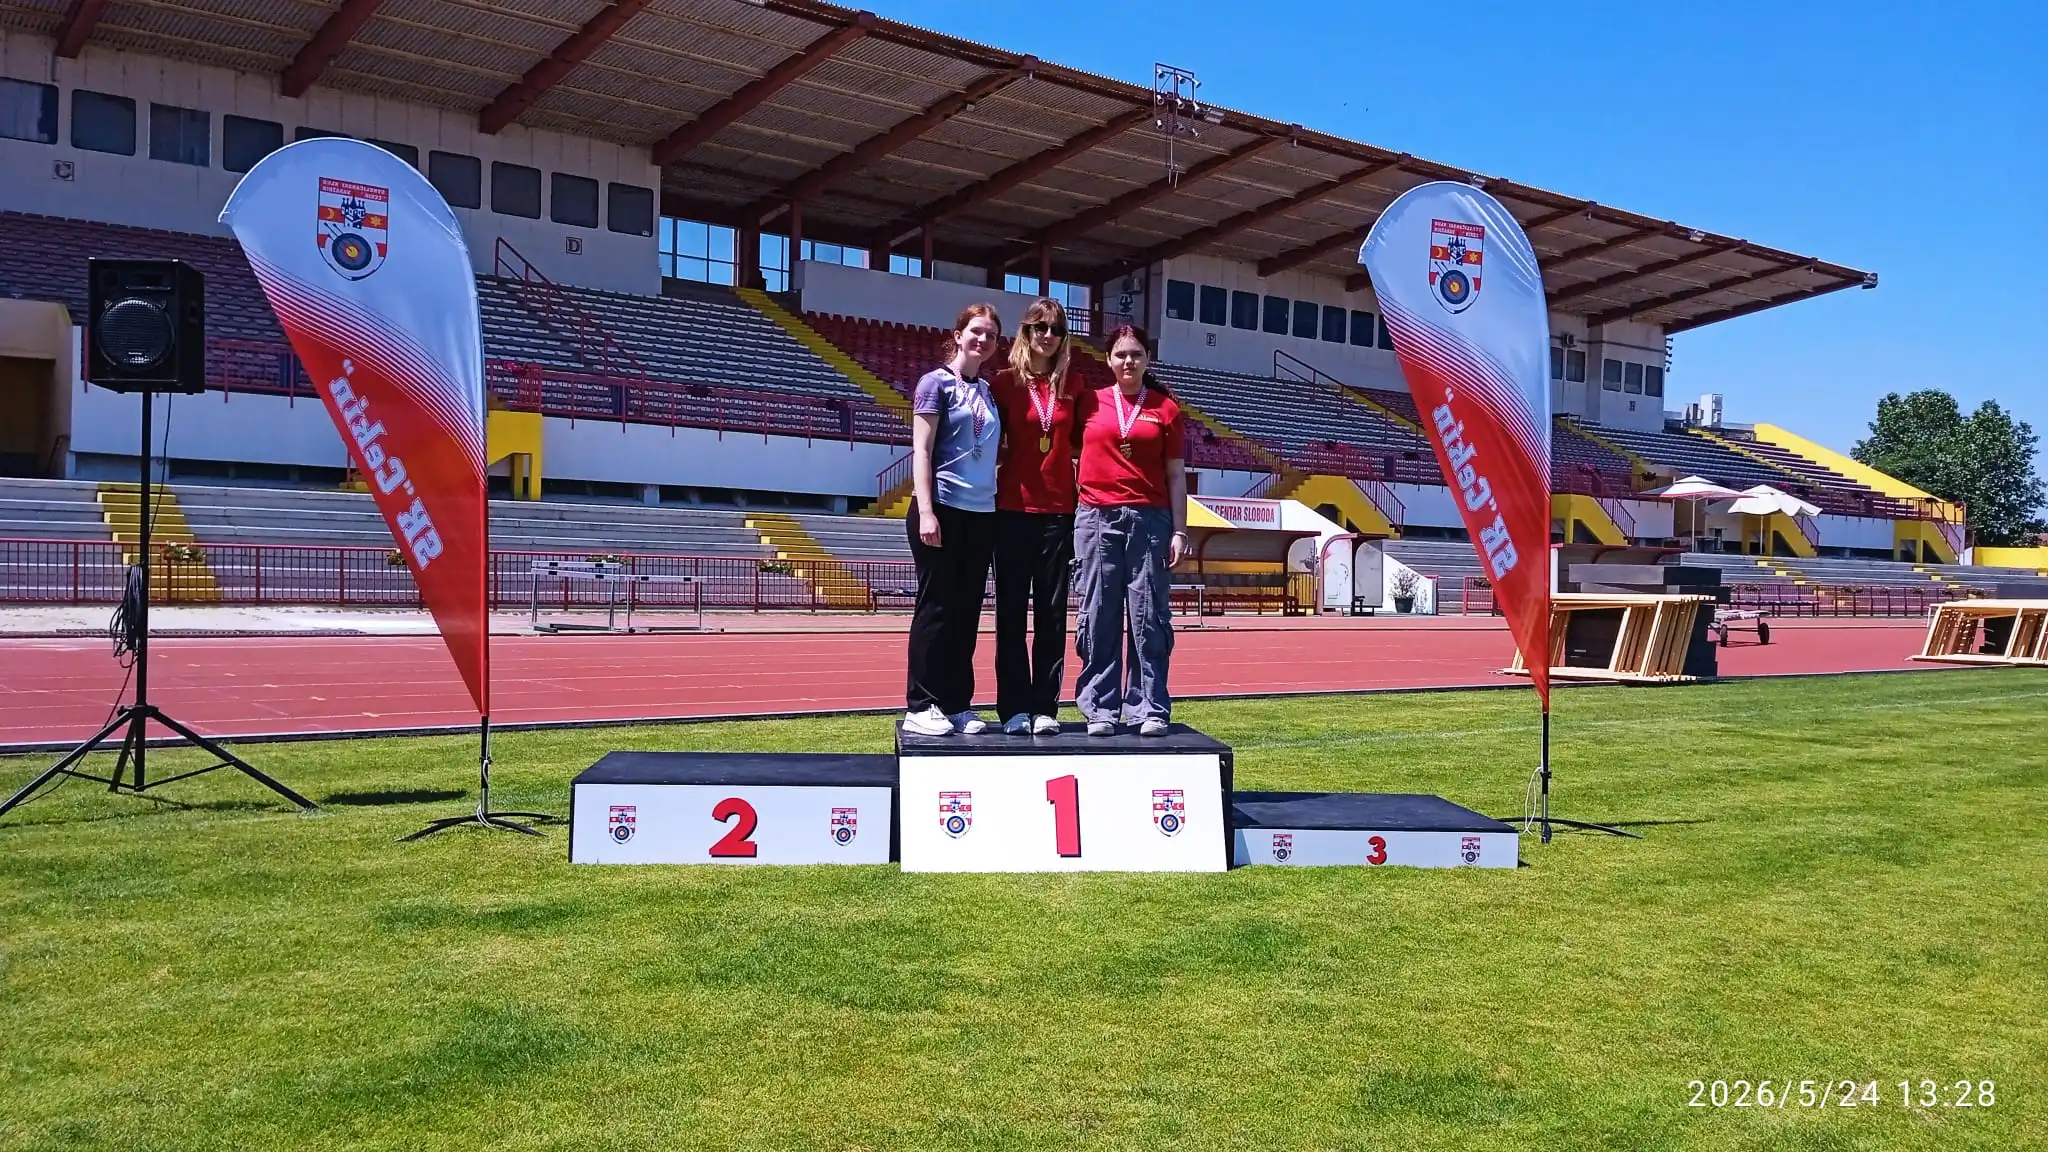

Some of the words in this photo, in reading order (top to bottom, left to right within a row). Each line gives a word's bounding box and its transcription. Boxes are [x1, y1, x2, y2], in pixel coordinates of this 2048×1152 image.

[55, 162, 71, 179] C
[568, 239, 581, 253] D
[1244, 506, 1275, 522] SLOBODA
[709, 797, 758, 858] 2
[1046, 775, 1082, 858] 1
[1366, 836, 1387, 865] 3
